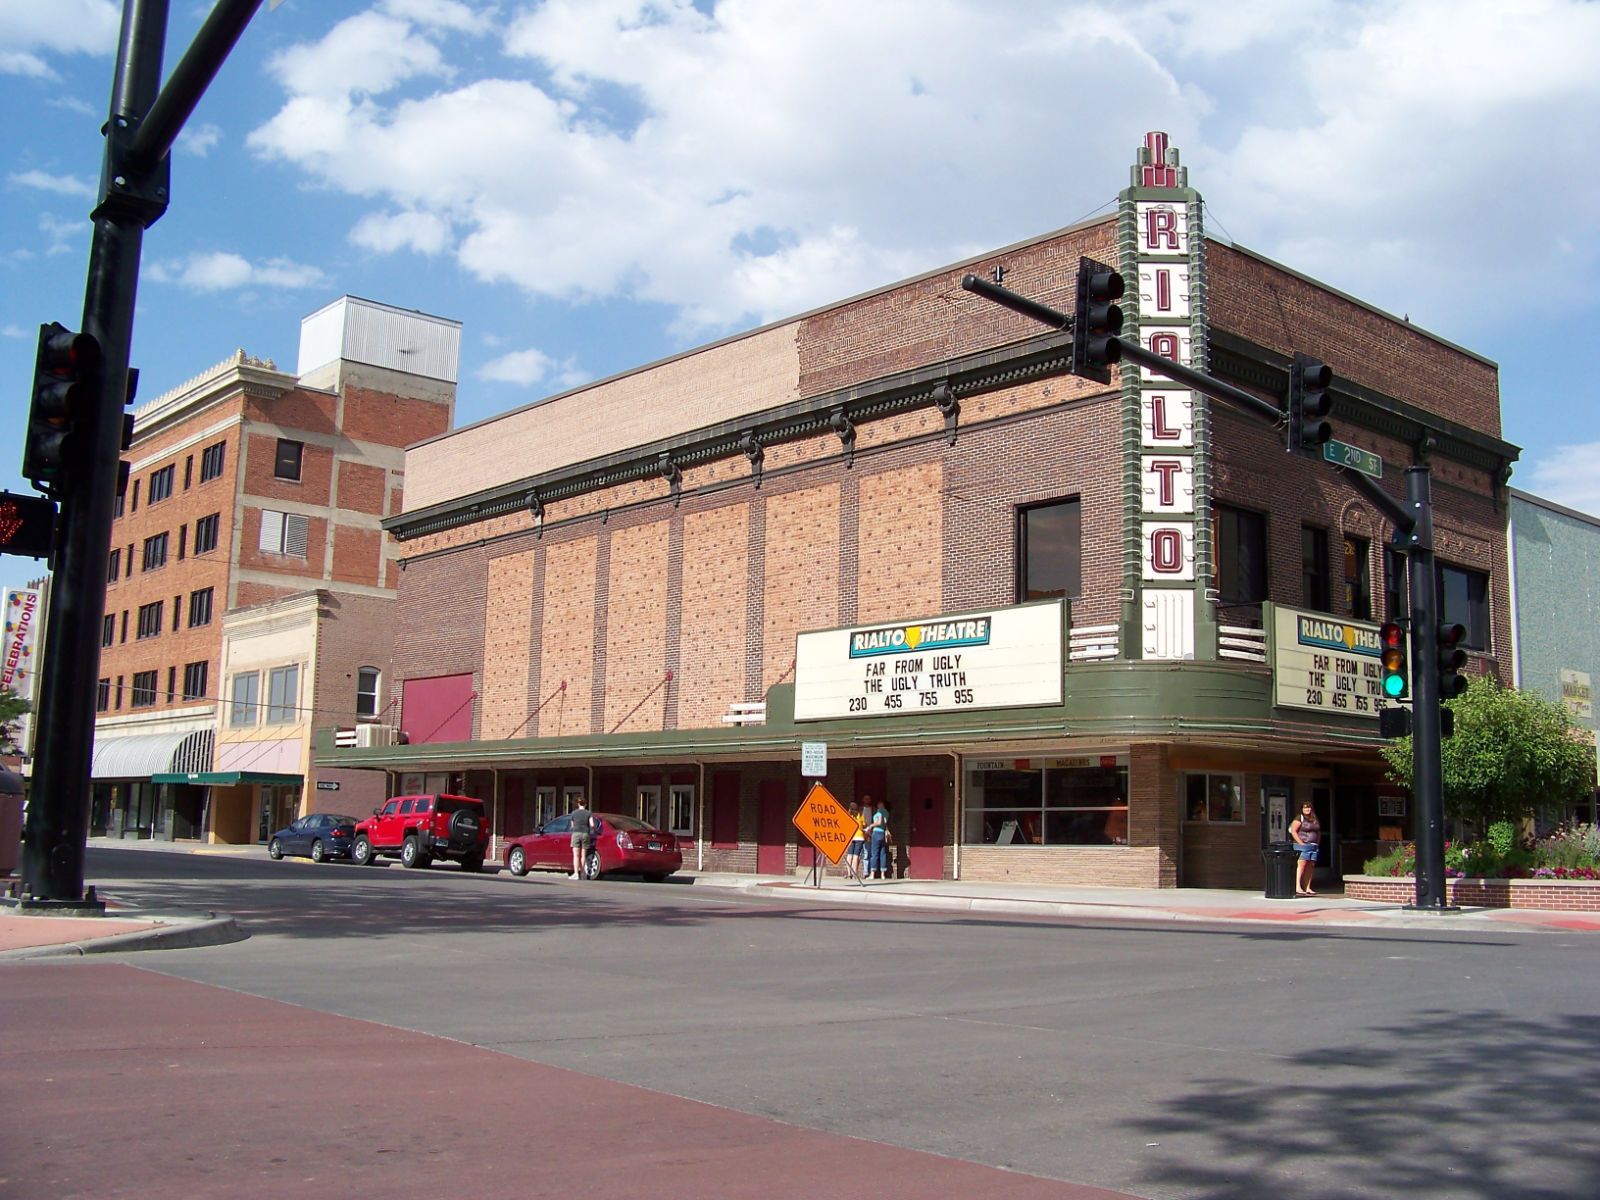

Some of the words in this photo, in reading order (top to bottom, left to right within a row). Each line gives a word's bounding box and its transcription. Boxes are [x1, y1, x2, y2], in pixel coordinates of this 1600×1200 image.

[1146, 207, 1184, 573] RIALTO
[1329, 443, 1336, 457] E
[1344, 446, 1361, 465] 2ND
[1368, 457, 1378, 472] ST
[0, 593, 37, 694] CELEBRATIONS
[854, 628, 906, 650] RIALTO
[920, 620, 986, 643] THEATRE
[1302, 619, 1343, 642] RIALTO
[1354, 629, 1381, 649] THEA
[866, 662, 886, 677] FAR
[895, 658, 923, 674] FROM
[933, 655, 961, 670] UGLY
[1314, 655, 1329, 670] FAR
[1335, 657, 1358, 675] FROM
[1363, 662, 1383, 679] UGLY
[864, 679, 883, 693] THE
[891, 675, 918, 691] UGLY
[929, 671, 966, 688] TRUTH
[1309, 671, 1325, 688] THE
[1336, 675, 1357, 692] UGLY
[1366, 680, 1381, 696] TRU
[849, 697, 867, 711] 230
[884, 694, 902, 709] 455
[919, 691, 938, 706] 755
[954, 689, 974, 704] 955
[1307, 689, 1323, 705] 230
[1332, 693, 1347, 708] 455
[1355, 695, 1368, 711] 755
[810, 803, 837, 815] ROAD
[812, 817, 841, 829] WORK
[814, 831, 847, 842] AHEAD
